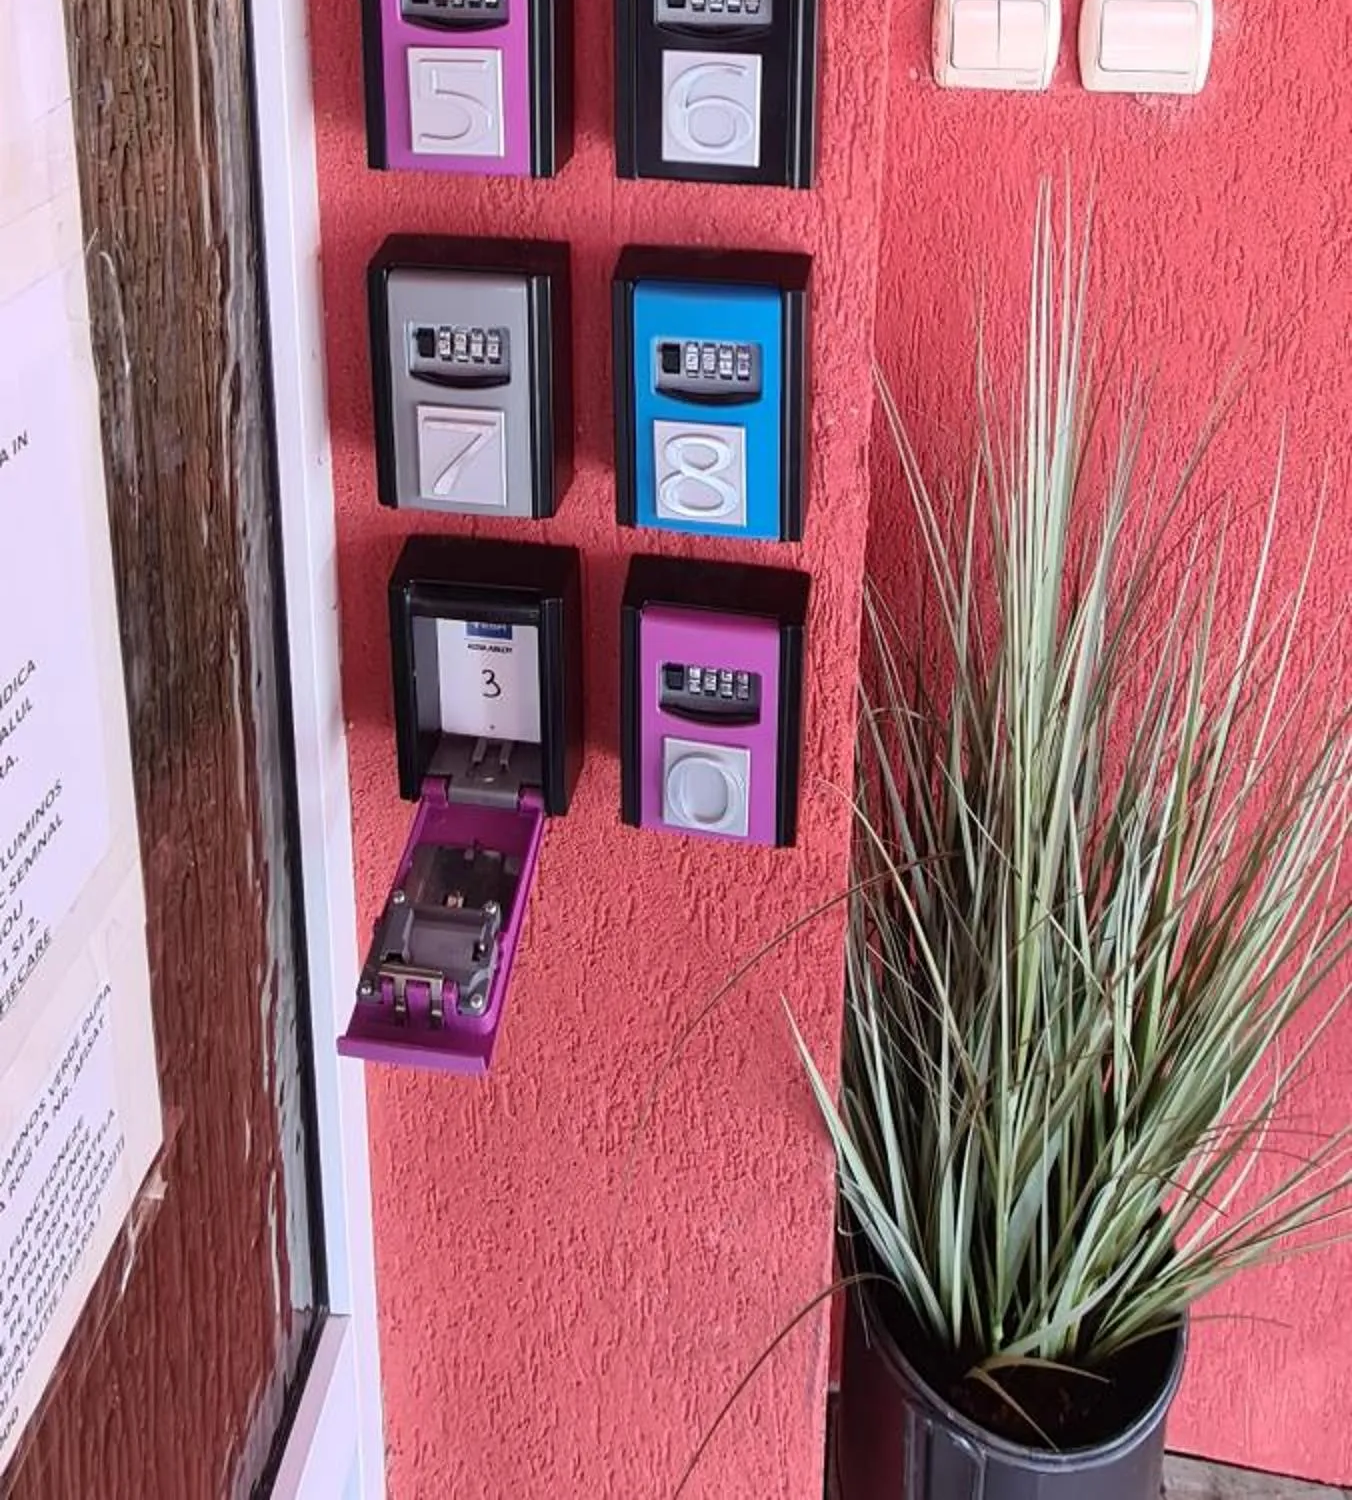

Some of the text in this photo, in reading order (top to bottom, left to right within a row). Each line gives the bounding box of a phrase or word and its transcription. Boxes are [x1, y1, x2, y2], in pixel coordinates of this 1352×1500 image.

[417, 57, 493, 149] 5
[667, 61, 754, 159] 6
[13, 430, 28, 455] IN
[422, 415, 498, 497] 7
[659, 431, 738, 518] 8
[0, 660, 36, 711] DICA
[481, 668, 502, 698] 3
[0, 778, 63, 873] LUMINOS
[9, 812, 63, 896] SEMNAL
[0, 899, 23, 945] OU
[12, 932, 24, 960] SI
[34, 1120, 49, 1148] LA
